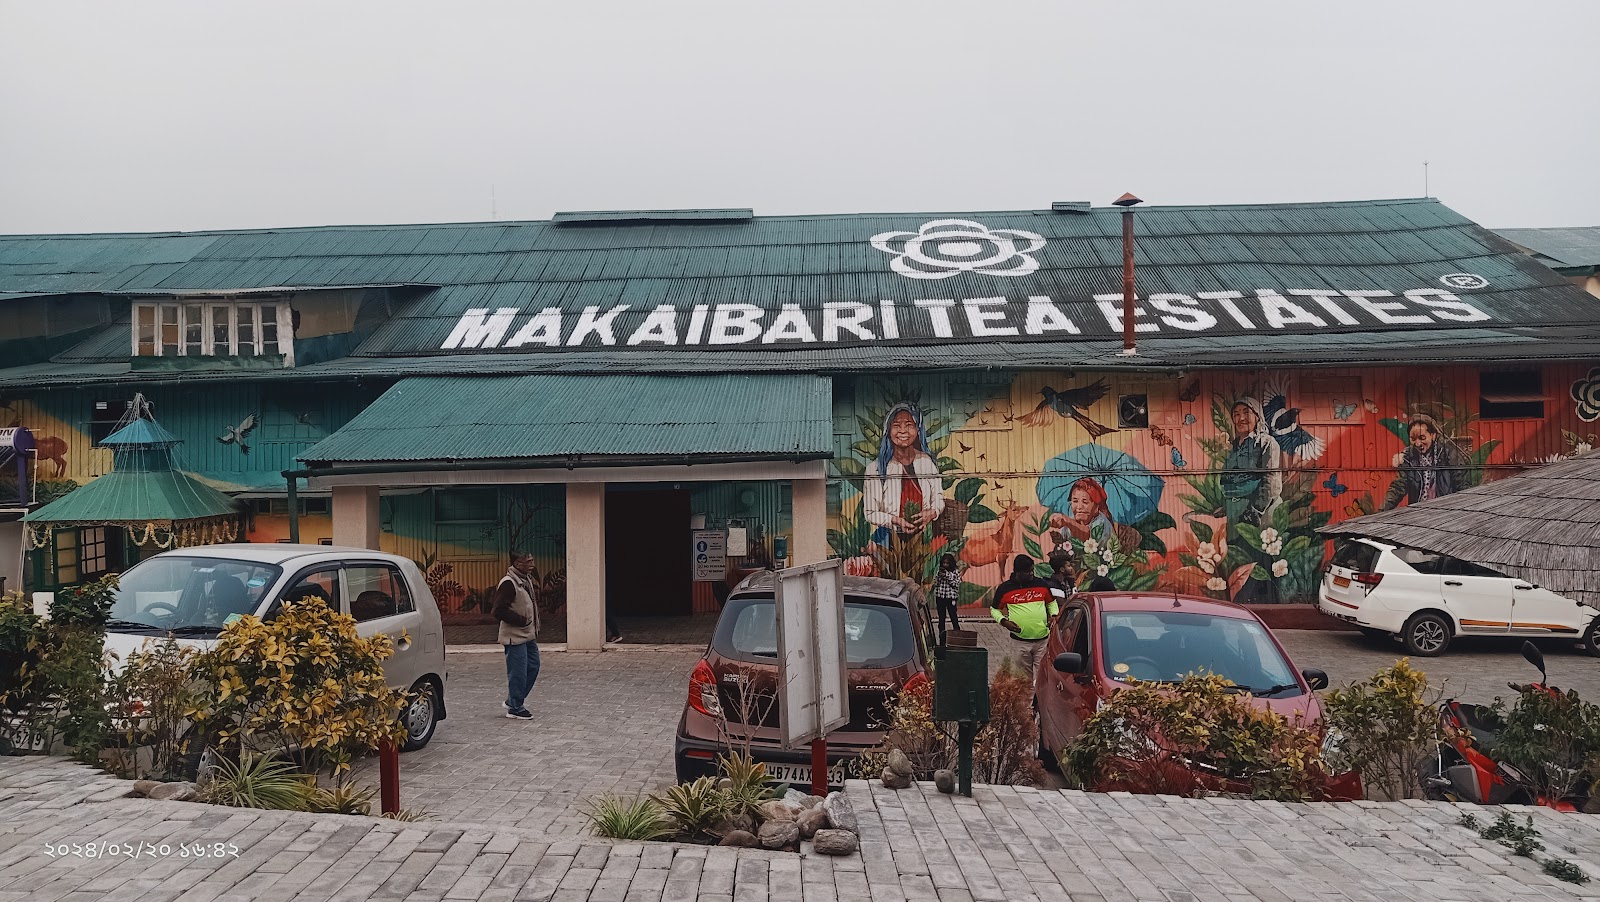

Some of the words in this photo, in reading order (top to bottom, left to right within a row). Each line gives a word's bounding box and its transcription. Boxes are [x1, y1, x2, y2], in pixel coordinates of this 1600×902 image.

[440, 299, 899, 350] MAKAIBARI
[912, 295, 1082, 338] TEA
[1093, 288, 1492, 333] ESTATES
